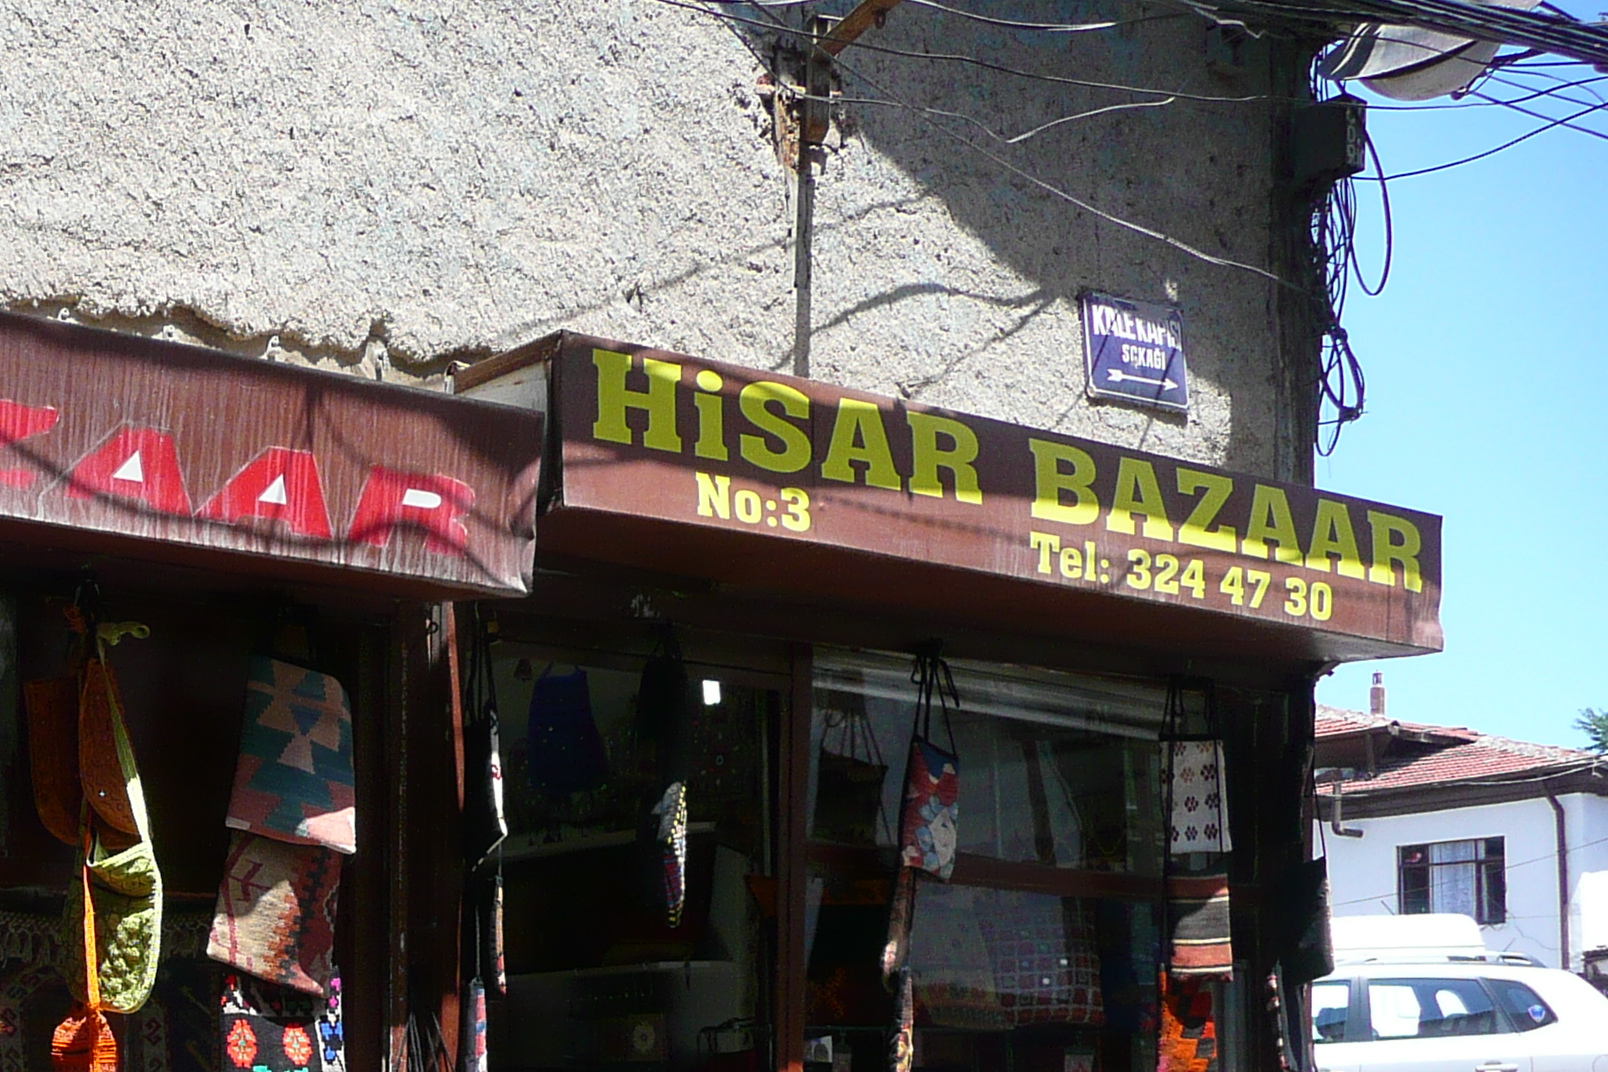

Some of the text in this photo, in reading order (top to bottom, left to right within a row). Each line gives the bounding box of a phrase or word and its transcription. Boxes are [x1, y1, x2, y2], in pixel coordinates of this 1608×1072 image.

[1092, 304, 1137, 341] KALE
[695, 471, 812, 532] No:3
[1029, 437, 1423, 593] BAZAAR
[1029, 531, 1334, 621] Tel: 324 47 30
